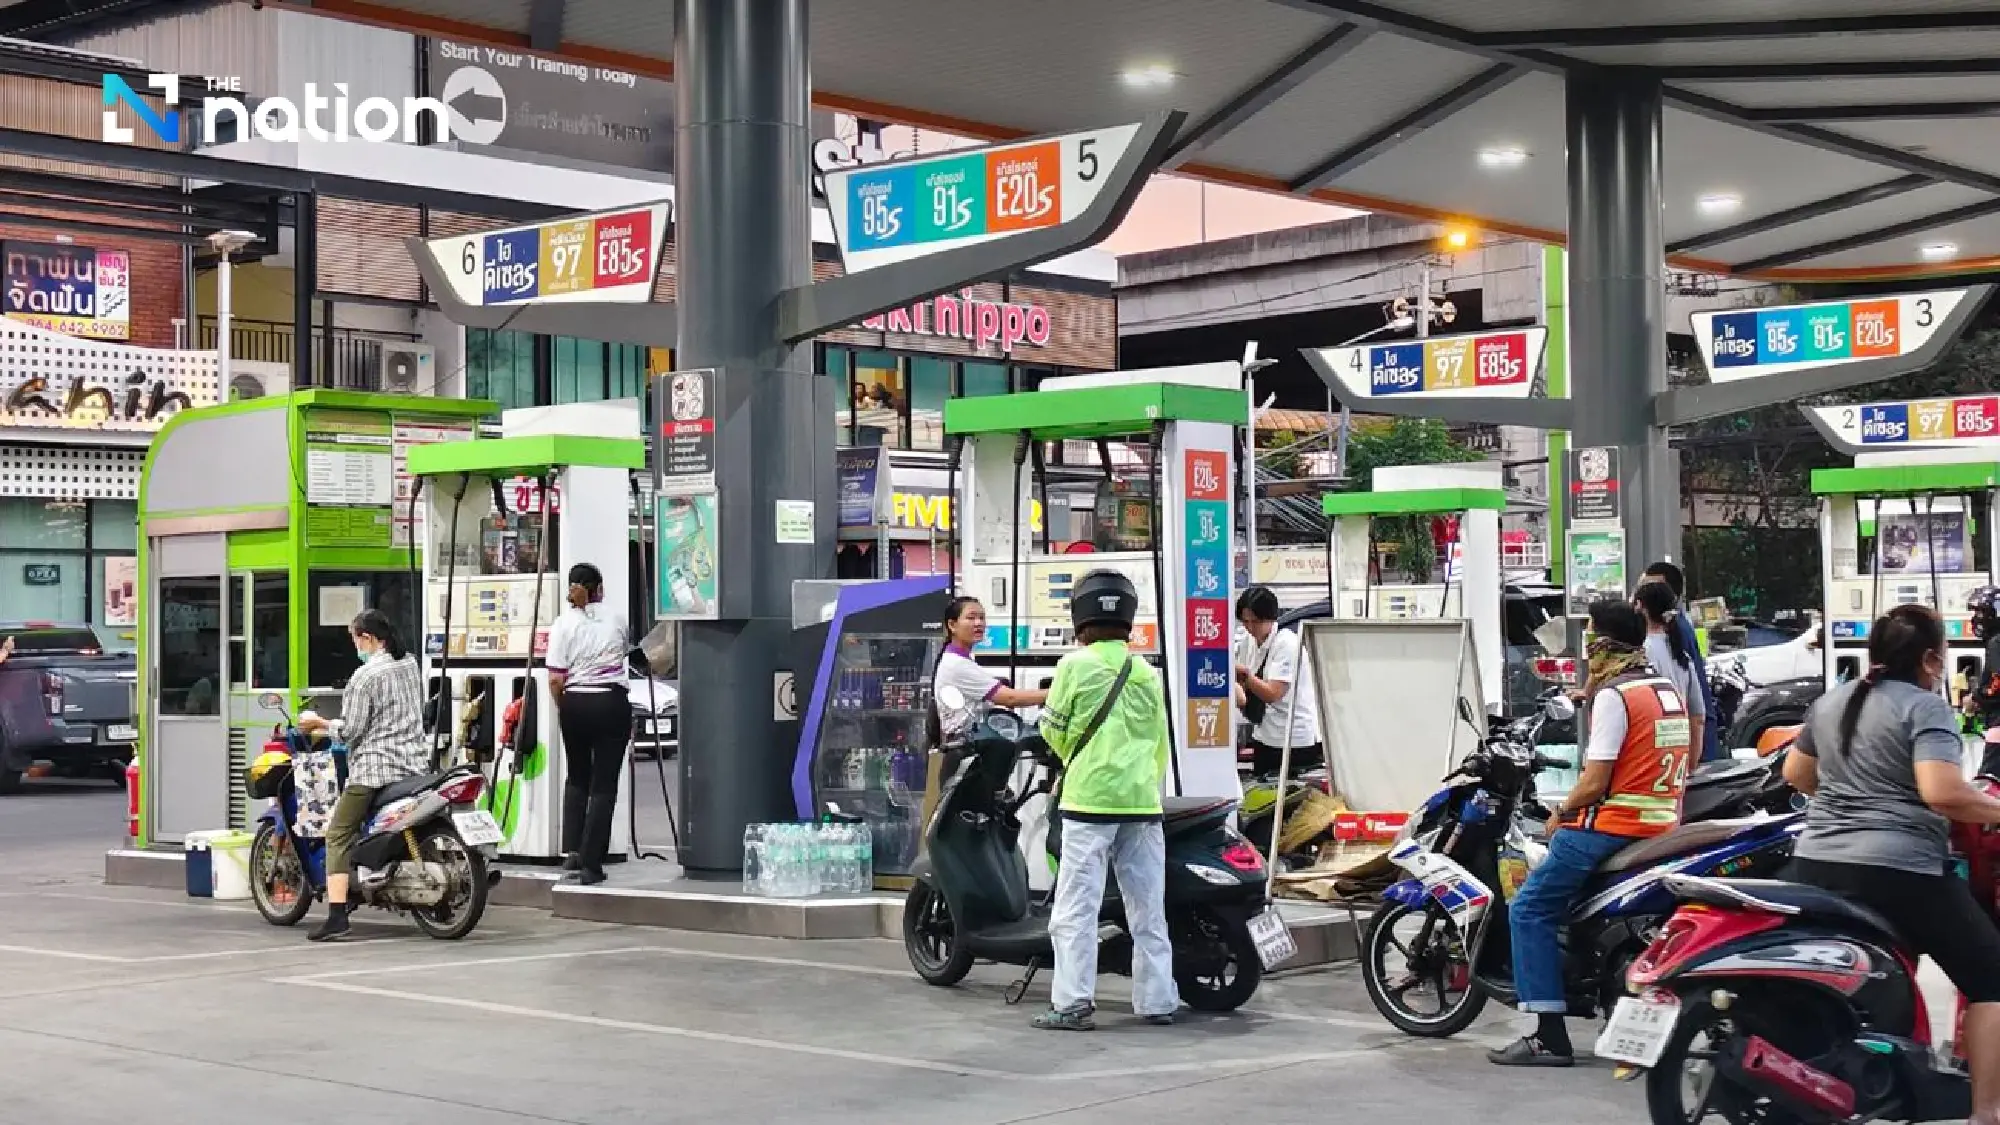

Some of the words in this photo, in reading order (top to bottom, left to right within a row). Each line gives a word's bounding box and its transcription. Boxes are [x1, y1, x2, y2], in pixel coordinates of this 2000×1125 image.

[440, 41, 479, 63] Start
[485, 48, 522, 69] Your
[528, 54, 589, 83] Training
[594, 66, 638, 89] Today
[1077, 138, 1098, 181] 5
[461, 240, 476, 276] 6
[552, 243, 582, 278] 97
[117, 274, 127, 288] 2
[8, 279, 93, 315] จัดฟัน
[934, 286, 1050, 352] hippo
[1916, 298, 1933, 327] 3
[1349, 348, 1363, 373] 4
[1436, 355, 1463, 380] 97
[1144, 404, 1159, 418] 10
[1842, 410, 1855, 429] 2
[1919, 414, 1944, 433] 97
[1198, 713, 1218, 737] 97
[1653, 752, 1689, 793] 24
